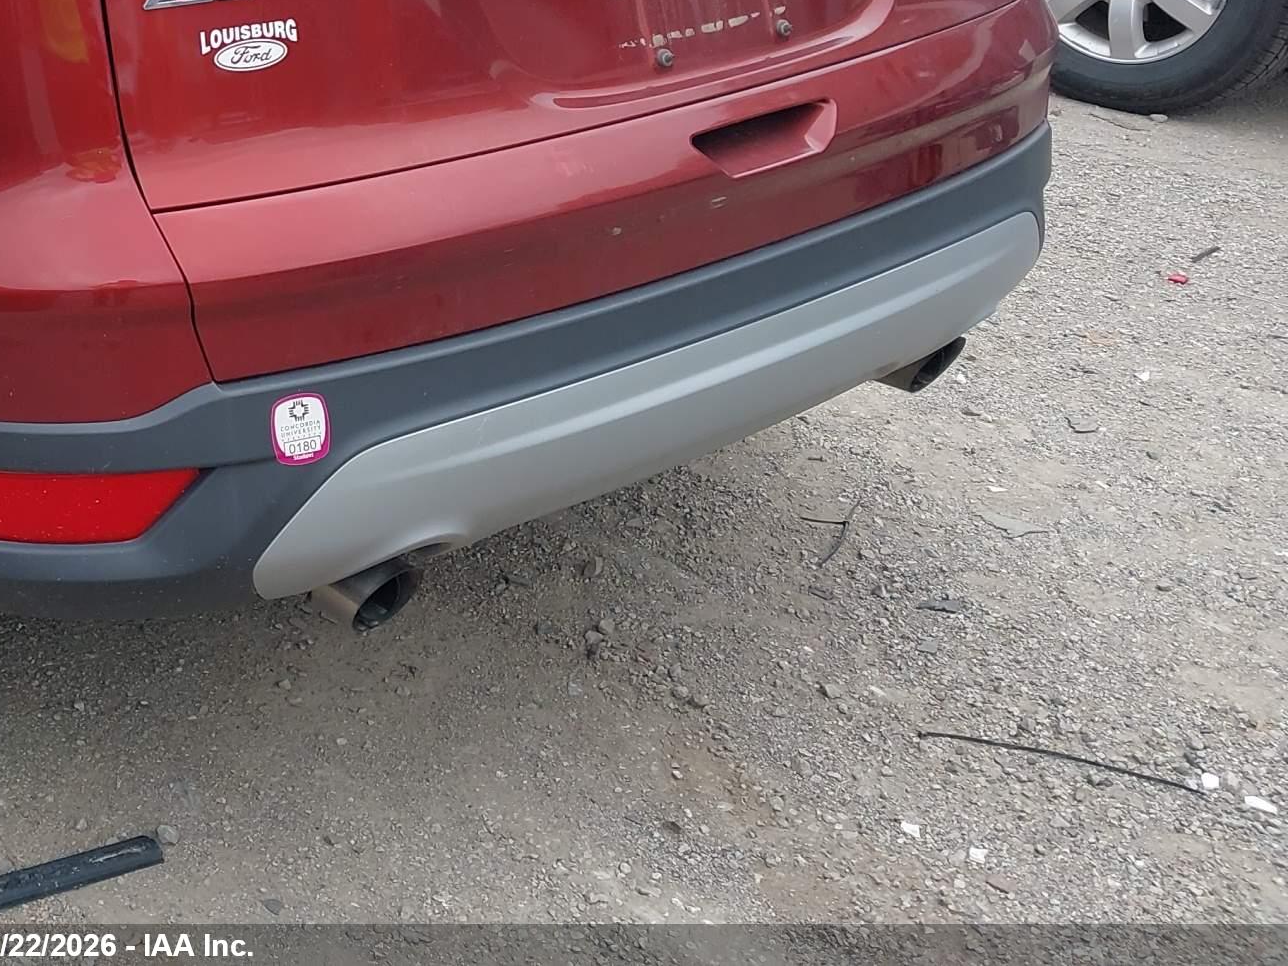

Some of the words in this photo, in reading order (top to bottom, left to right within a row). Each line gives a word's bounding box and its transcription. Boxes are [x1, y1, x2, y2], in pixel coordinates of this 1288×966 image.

[199, 18, 299, 56] LOUISBURG
[230, 44, 273, 66] Ford
[288, 439, 317, 454] 0180
